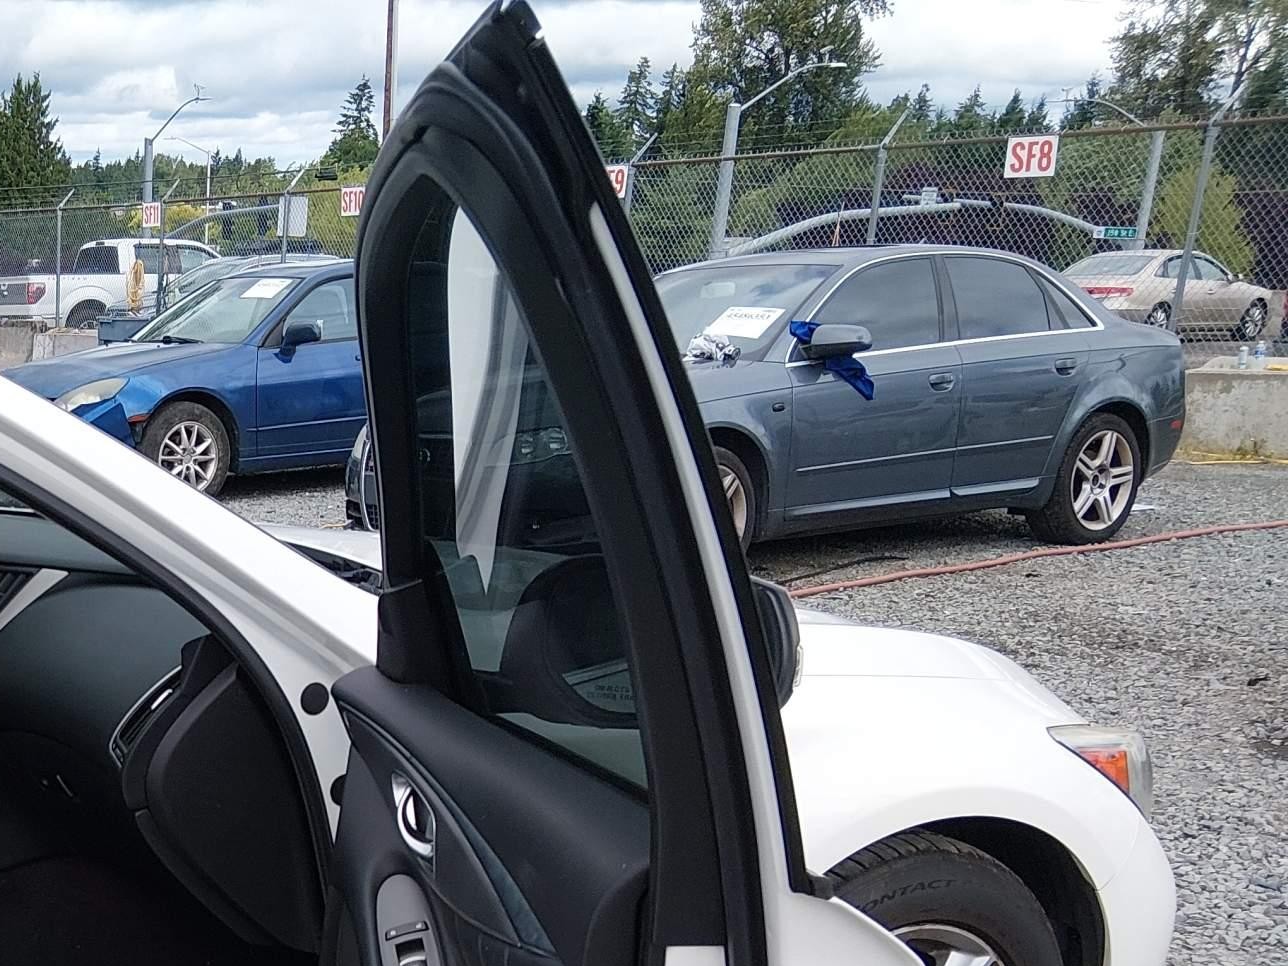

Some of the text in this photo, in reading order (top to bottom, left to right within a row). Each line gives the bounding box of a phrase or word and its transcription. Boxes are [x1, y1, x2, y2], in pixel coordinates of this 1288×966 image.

[1010, 140, 1053, 173] SF8
[343, 190, 364, 213] SF10
[144, 204, 159, 225] SF11
